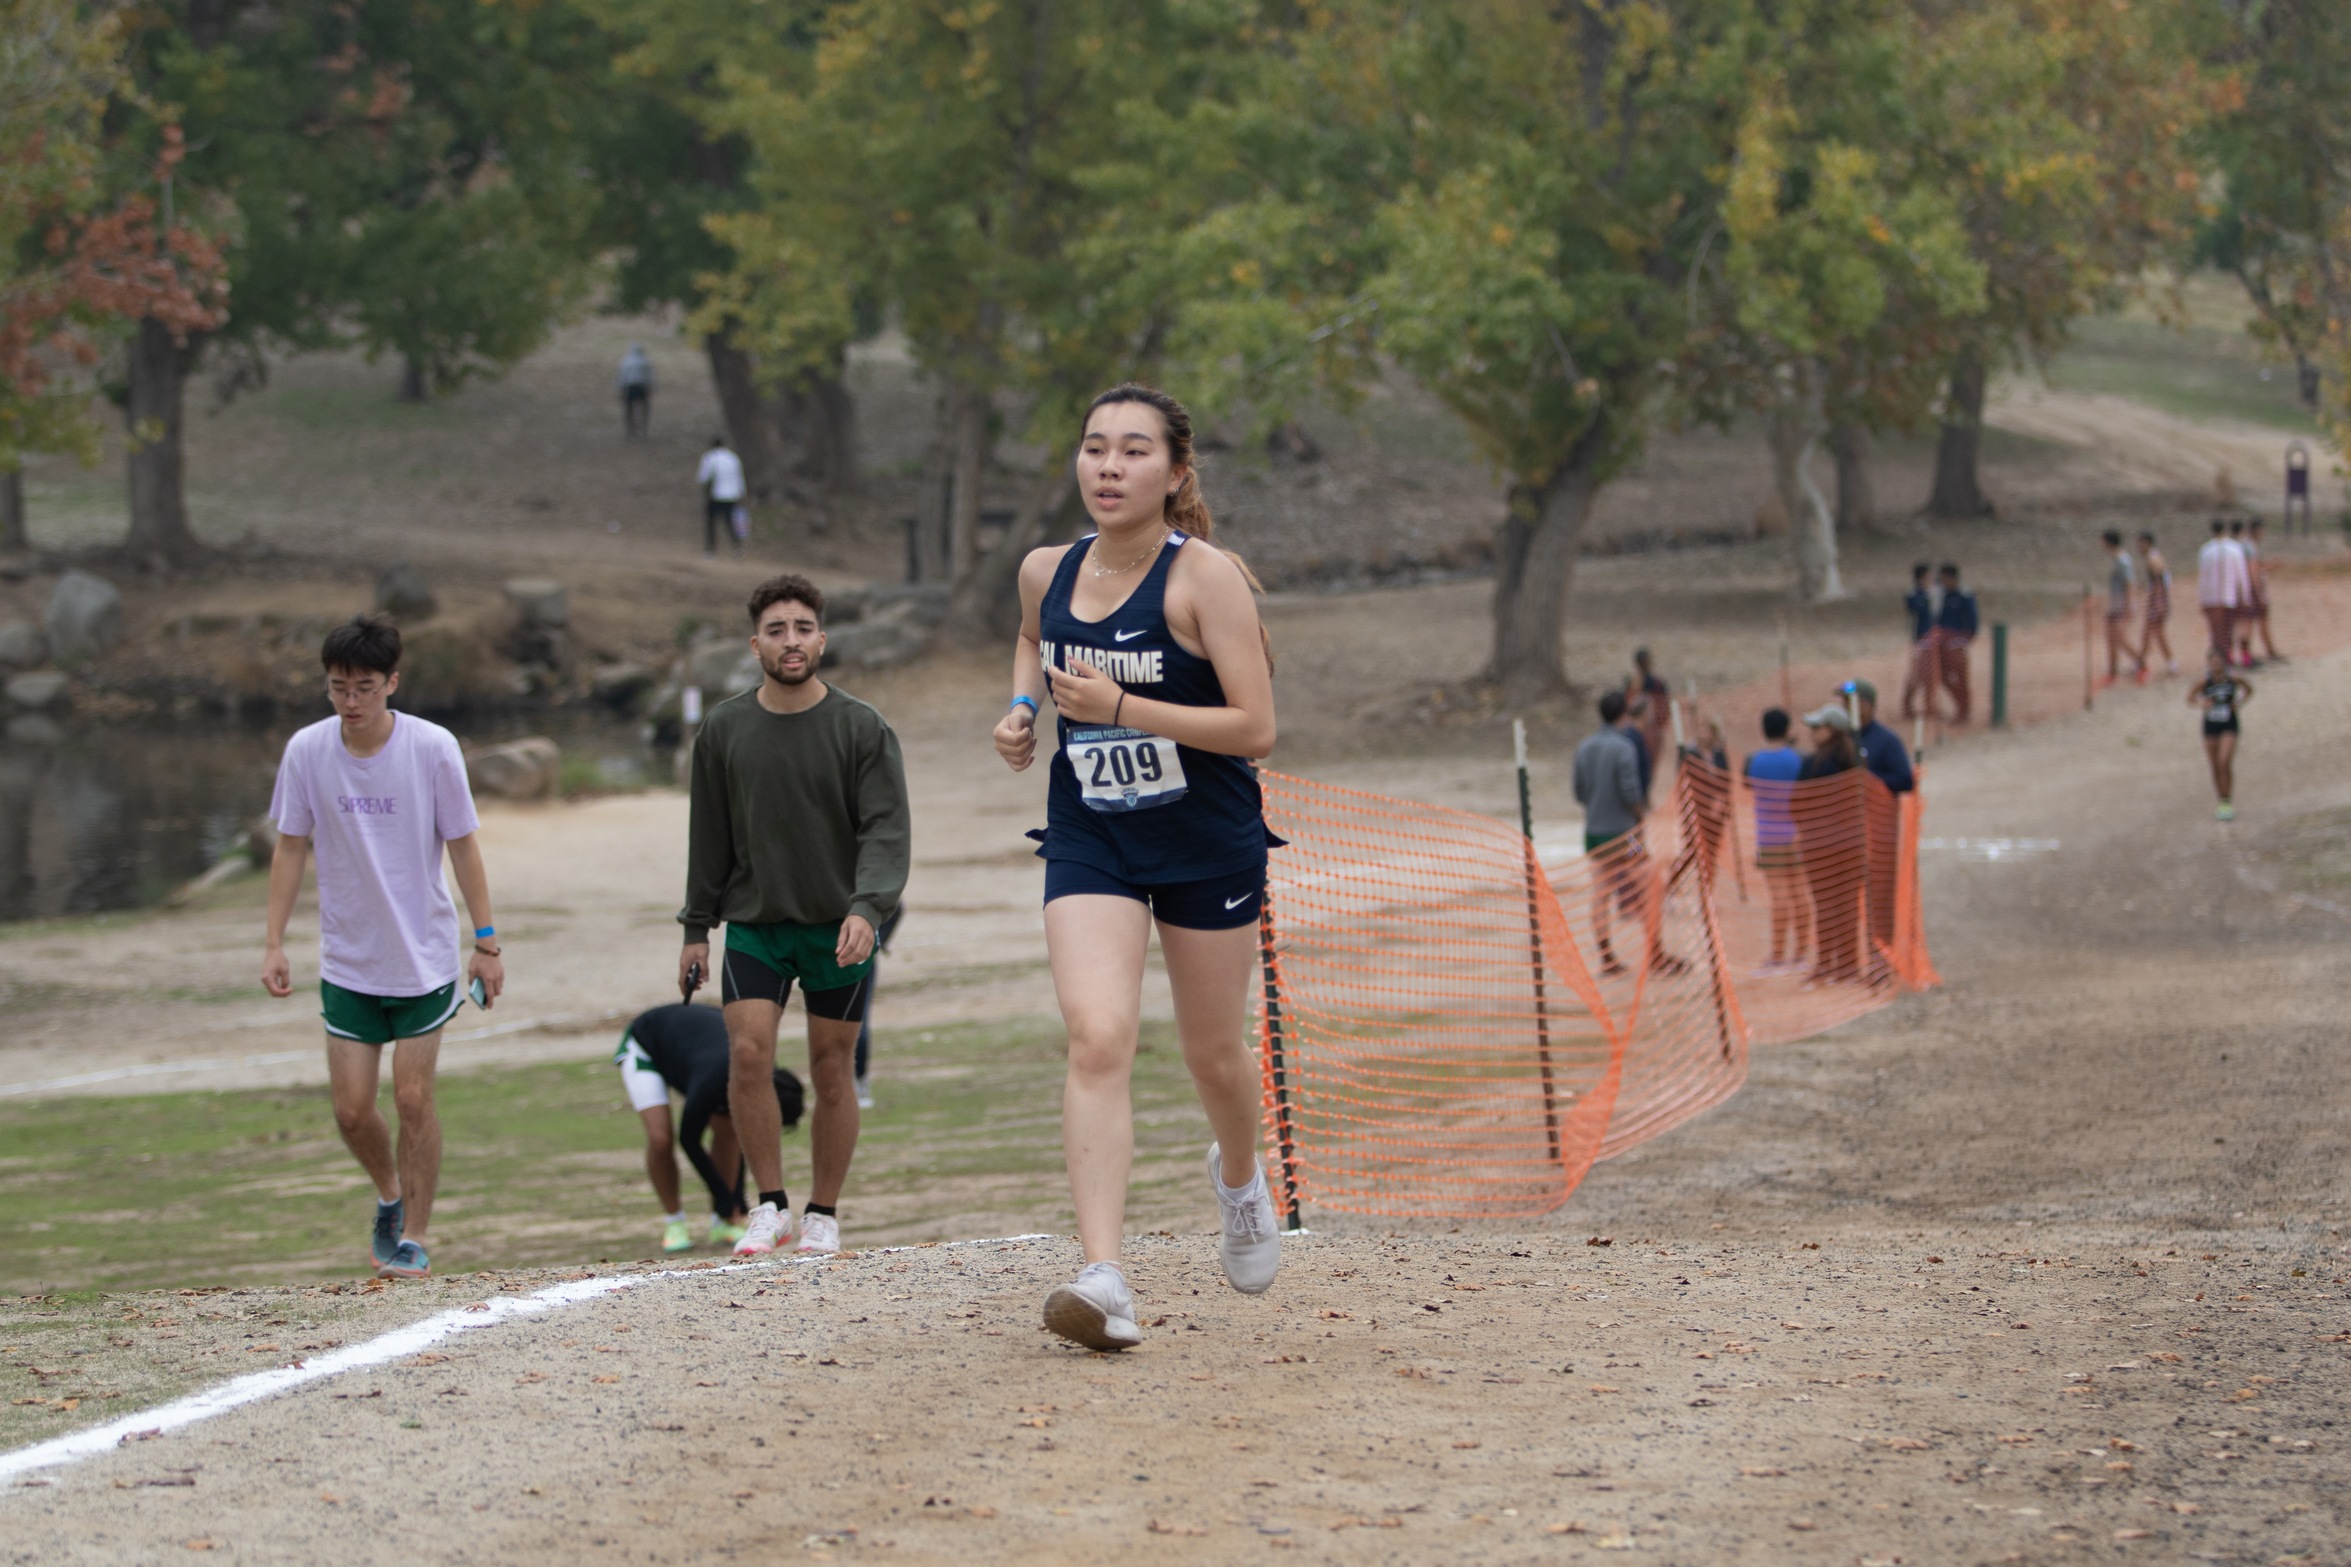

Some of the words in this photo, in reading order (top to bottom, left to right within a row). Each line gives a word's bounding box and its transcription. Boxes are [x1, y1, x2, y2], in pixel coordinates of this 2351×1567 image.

[1065, 645, 1163, 683] MARITIME
[1074, 731, 1103, 741] CALIFORNIA
[1103, 729, 1126, 739] PACIFIC
[1084, 742, 1163, 787] 209
